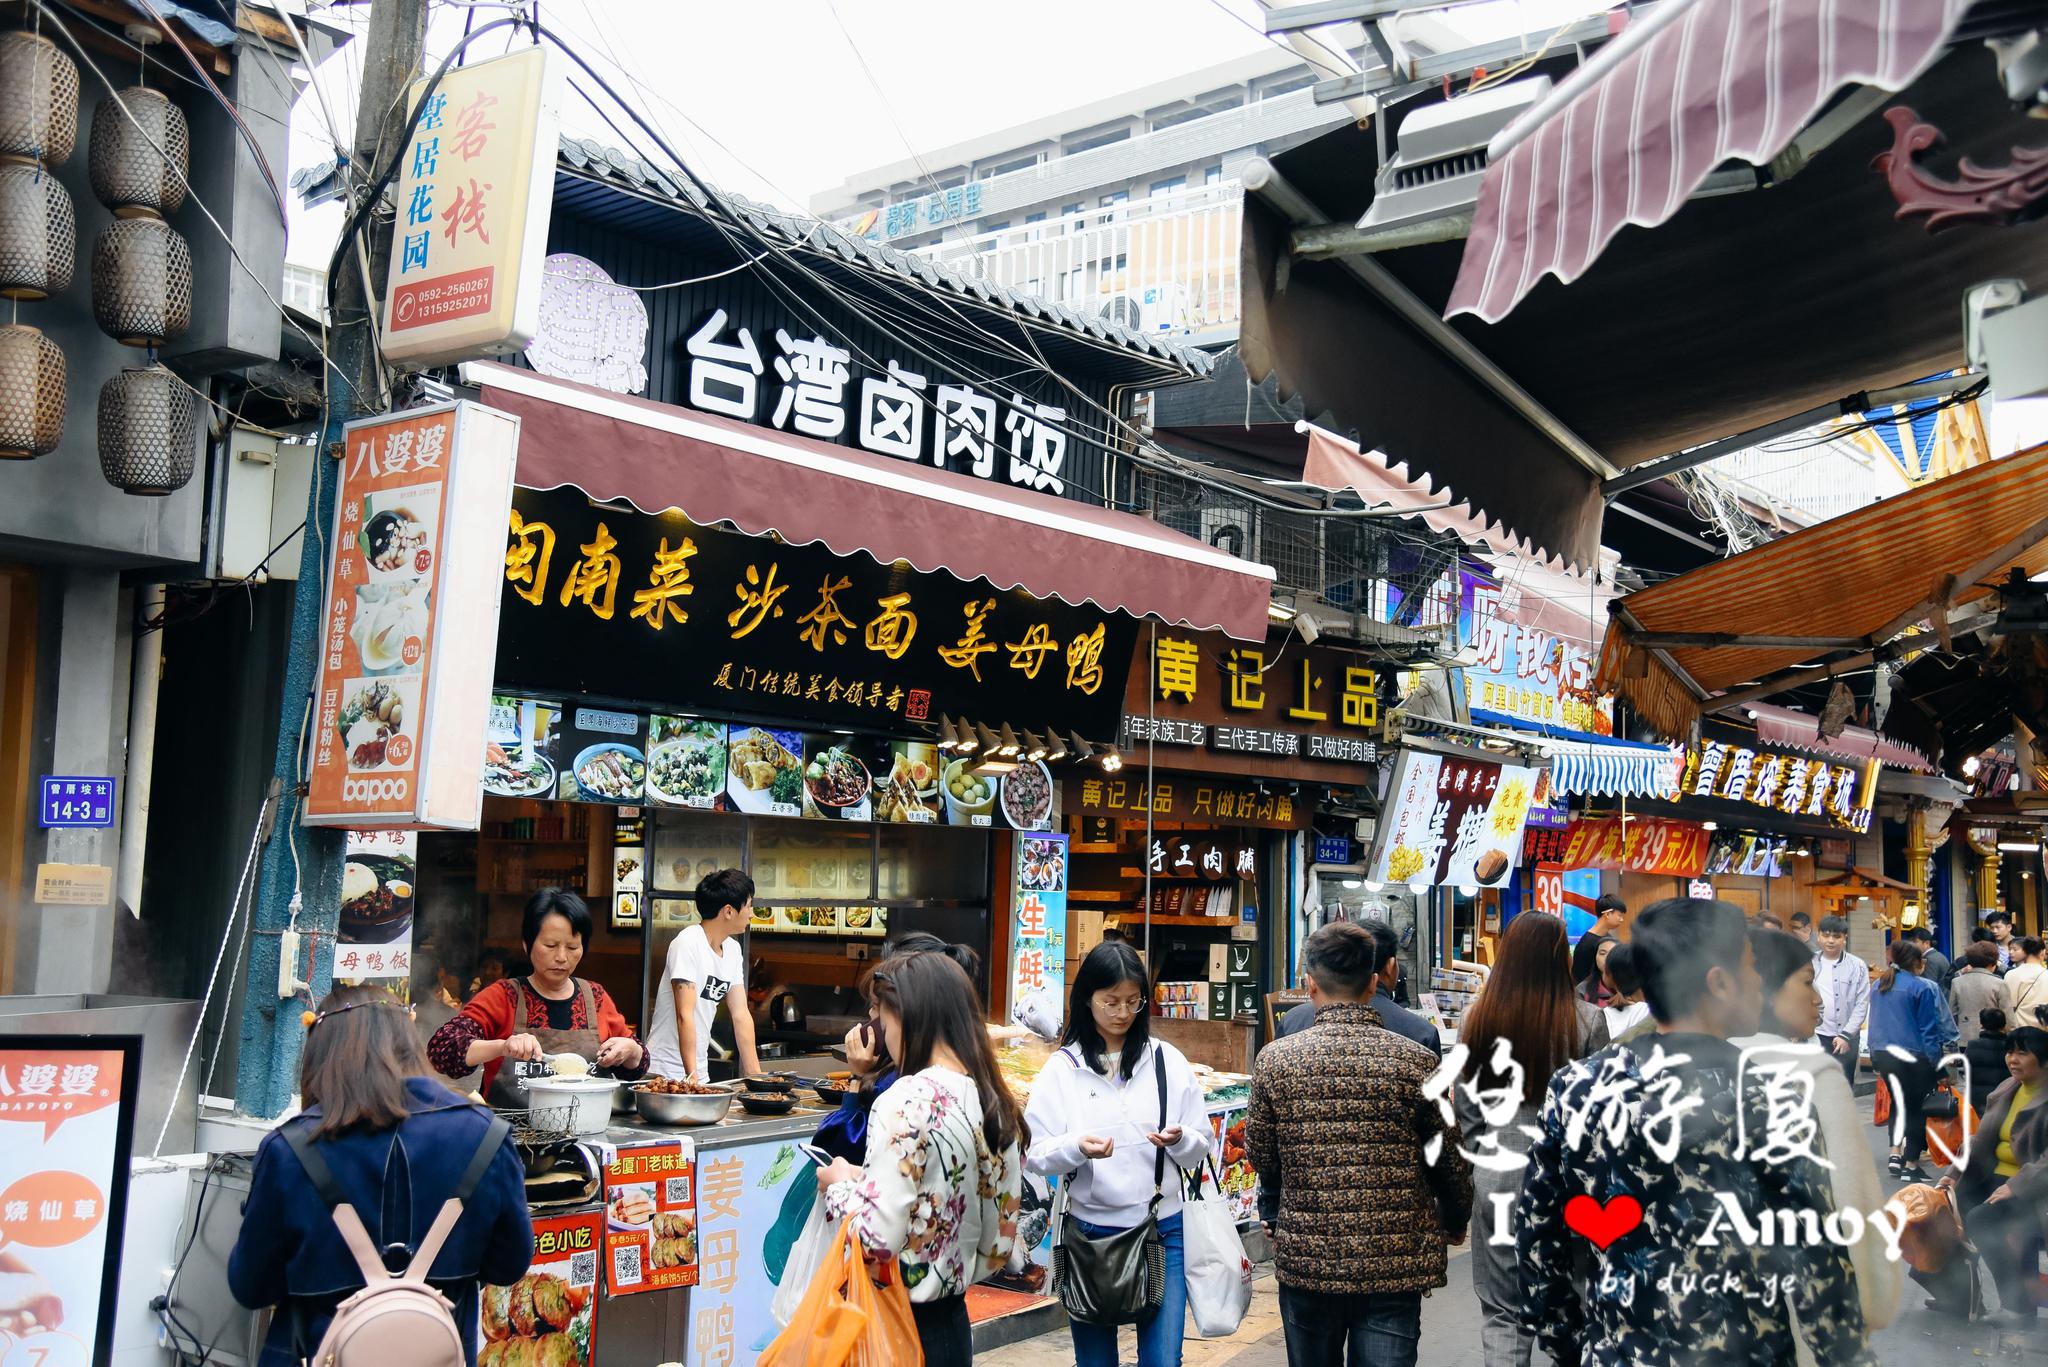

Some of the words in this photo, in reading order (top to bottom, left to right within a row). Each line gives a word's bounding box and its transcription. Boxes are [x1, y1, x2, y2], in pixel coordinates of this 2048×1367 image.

[441, 89, 498, 248] 客栈
[418, 294, 489, 318] 13159252071
[419, 278, 489, 302] 0592-2560267
[688, 309, 1067, 496] 台湾卤肉饭
[349, 424, 446, 482] 八婆婆
[339, 501, 359, 579] 烧仙草
[505, 508, 700, 631] 闽南菜
[727, 562, 919, 660] 沙茶面
[938, 598, 1107, 697] 姜母鸭
[329, 598, 348, 670] 小笼汤包
[713, 662, 905, 712] 厦门传统美食领导者
[1156, 637, 1378, 728] 黄记上品
[318, 689, 337, 767] 豆花粉丝
[1217, 727, 1298, 755] 三代手工传承
[1310, 736, 1376, 763] 只做好肉脯
[51, 801, 91, 819] 14-3
[343, 775, 407, 806] bapoo
[1082, 779, 1172, 813] 黄记上品
[1193, 788, 1293, 822] 只做好肉脯
[1149, 839, 1256, 874] 手工肉脯
[1320, 849, 1338, 860] 34-1
[1537, 875, 1562, 917] 39
[1018, 894, 1047, 988] 生蚝
[4, 1199, 97, 1222] 烧仙草
[696, 1155, 744, 1367] 姜母鸭
